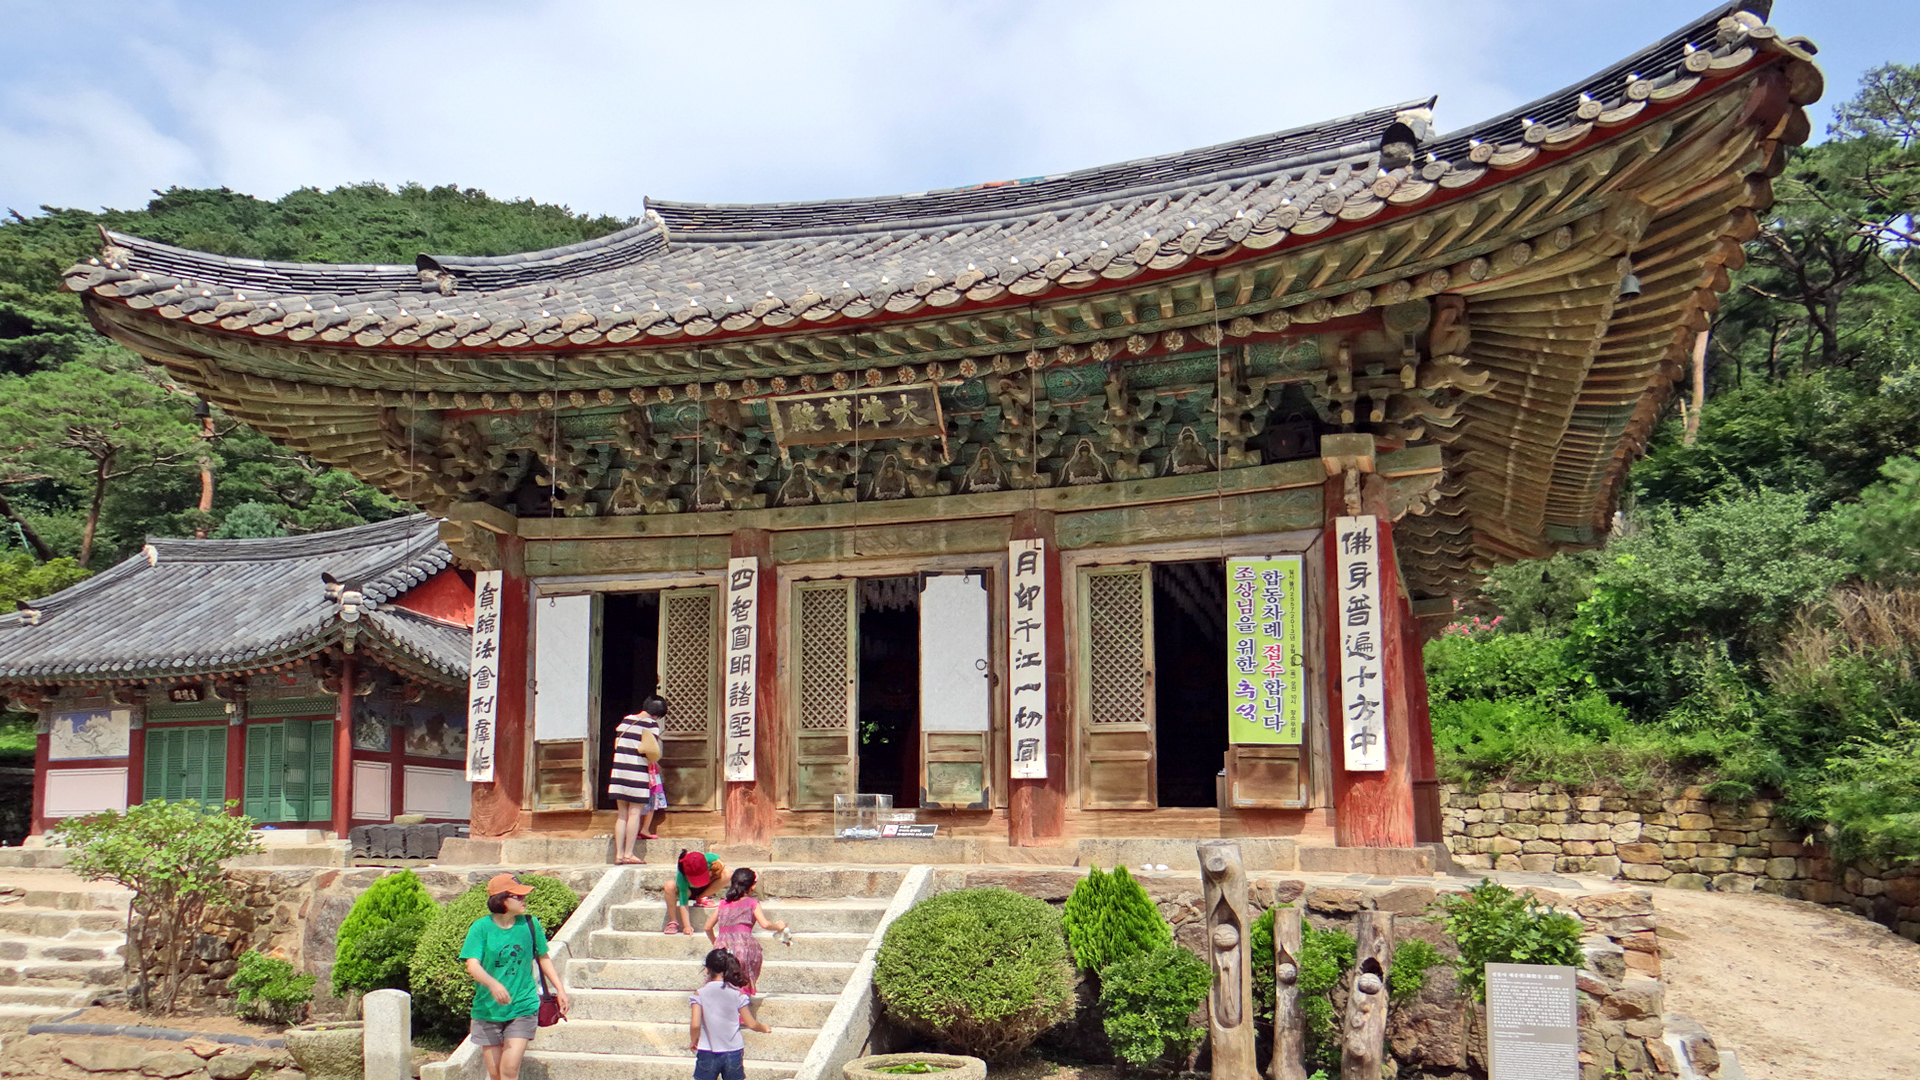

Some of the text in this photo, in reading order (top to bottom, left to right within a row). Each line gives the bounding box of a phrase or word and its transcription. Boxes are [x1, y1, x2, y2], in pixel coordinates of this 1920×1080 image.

[1234, 566, 1257, 721] 조상님을 위한 추석
[1262, 570, 1287, 733] 합동차례 접수합니다
[1341, 527, 1380, 756] 佛身普遍十方中
